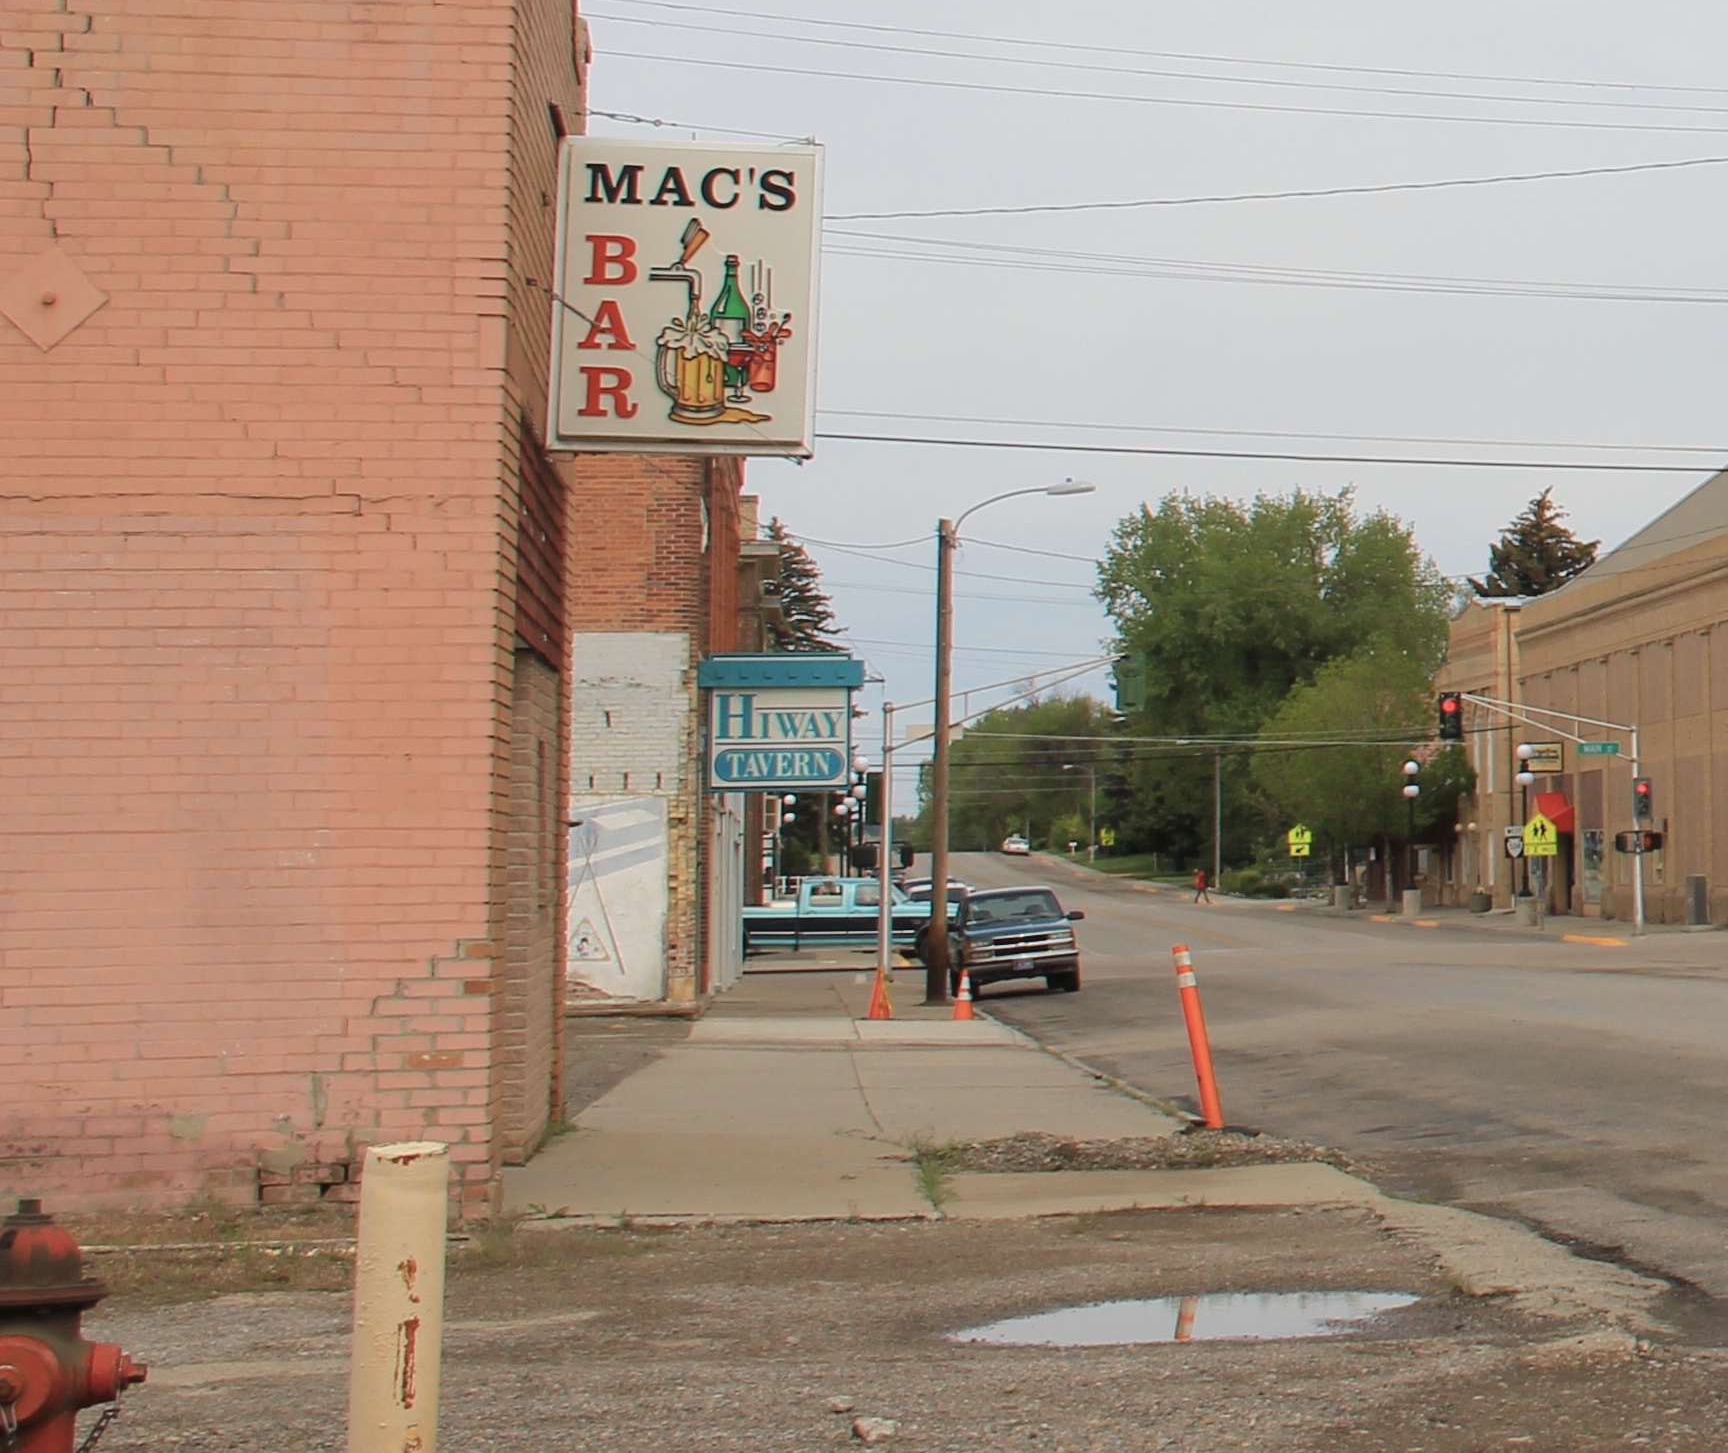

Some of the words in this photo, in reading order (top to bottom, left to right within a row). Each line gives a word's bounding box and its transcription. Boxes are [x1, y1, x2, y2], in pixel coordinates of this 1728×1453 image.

[585, 163, 798, 211] MAC'S
[577, 234, 640, 419] BAR
[714, 693, 845, 739] HIWAY
[726, 752, 831, 778] TAVERN
[1583, 743, 1602, 753] MAIN
